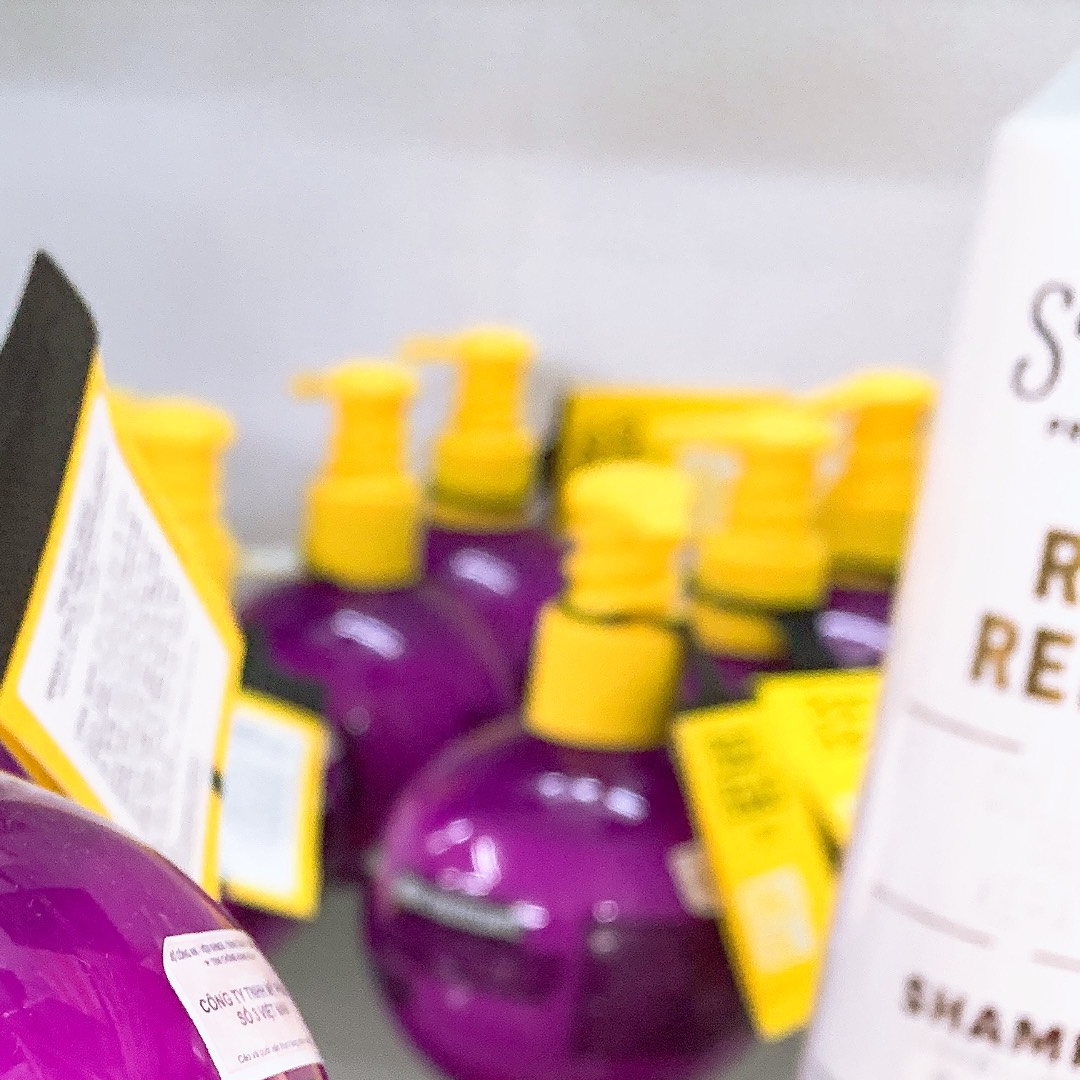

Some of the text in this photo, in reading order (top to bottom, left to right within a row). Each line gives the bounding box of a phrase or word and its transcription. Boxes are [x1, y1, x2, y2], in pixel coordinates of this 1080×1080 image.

[1010, 279, 1080, 402] S
[200, 993, 234, 1013] CÔNG
[231, 988, 246, 1004] TY
[902, 975, 1080, 1068] SHAM
